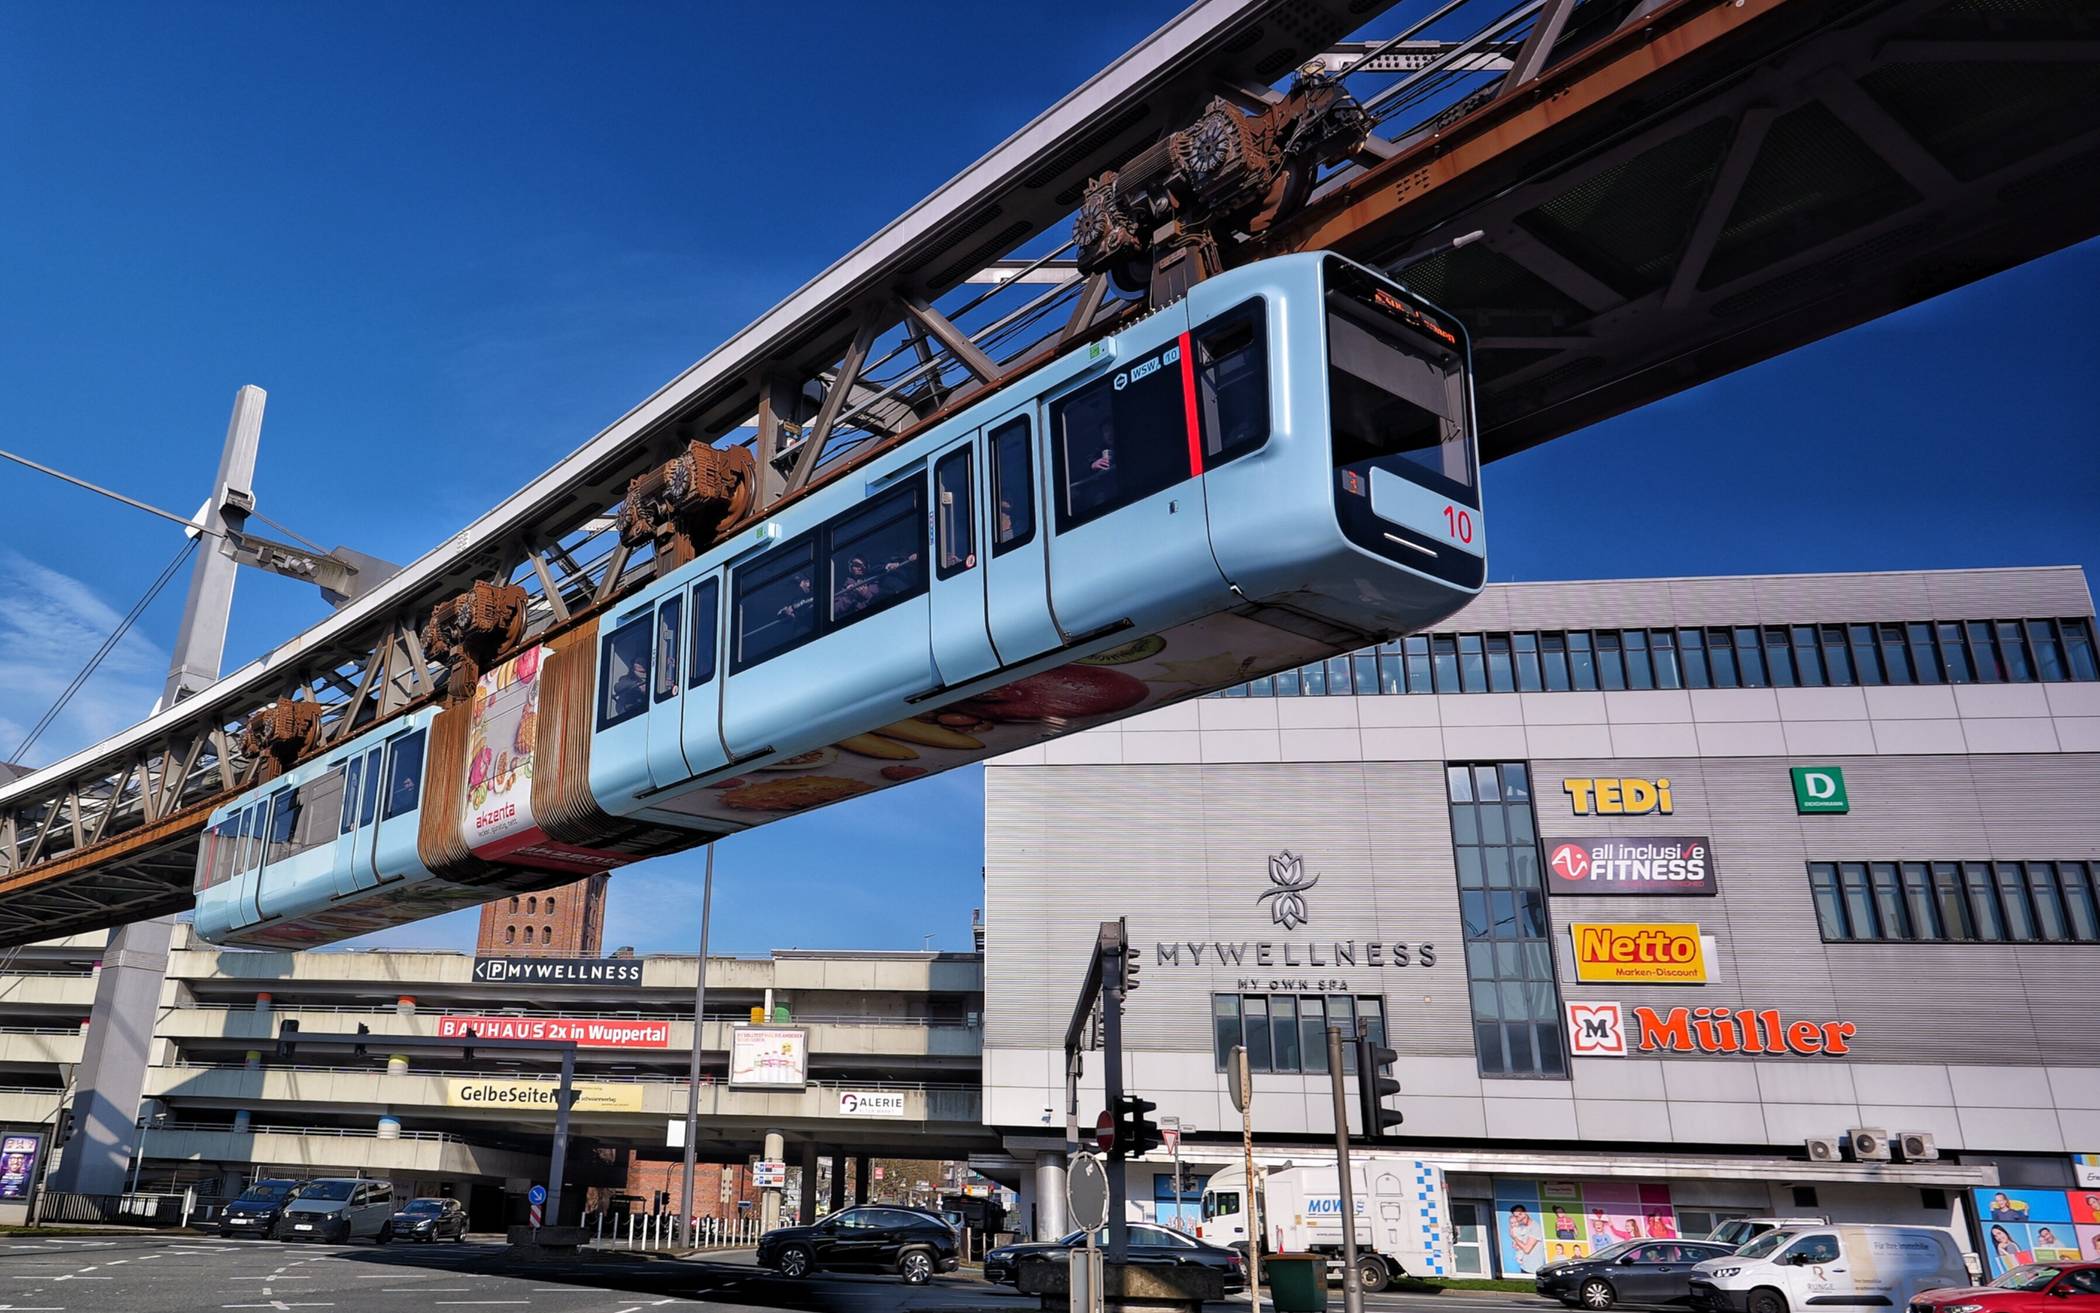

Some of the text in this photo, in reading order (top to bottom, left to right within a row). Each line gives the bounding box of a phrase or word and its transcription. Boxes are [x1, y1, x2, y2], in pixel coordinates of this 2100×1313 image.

[1443, 505, 1472, 544] 10
[1563, 777, 1674, 816] TEDi
[1804, 773, 1836, 798] D
[476, 802, 515, 828] akzenta
[1592, 843, 1705, 859] all inclusive
[1591, 860, 1705, 881] FITNESS
[1157, 941, 1438, 967] MYWELLNESS
[1582, 928, 1697, 964] Netto
[508, 964, 639, 980] MYWELLNESS
[1615, 967, 1699, 978] Marken-Discount
[1238, 979, 1348, 991] MY OWN SPA
[443, 1021, 666, 1043] BAUHAUS 2x in Wuppertal
[1583, 1018, 1609, 1039] M
[1633, 1006, 1857, 1055] Müller
[842, 1094, 903, 1112] GALERIE
